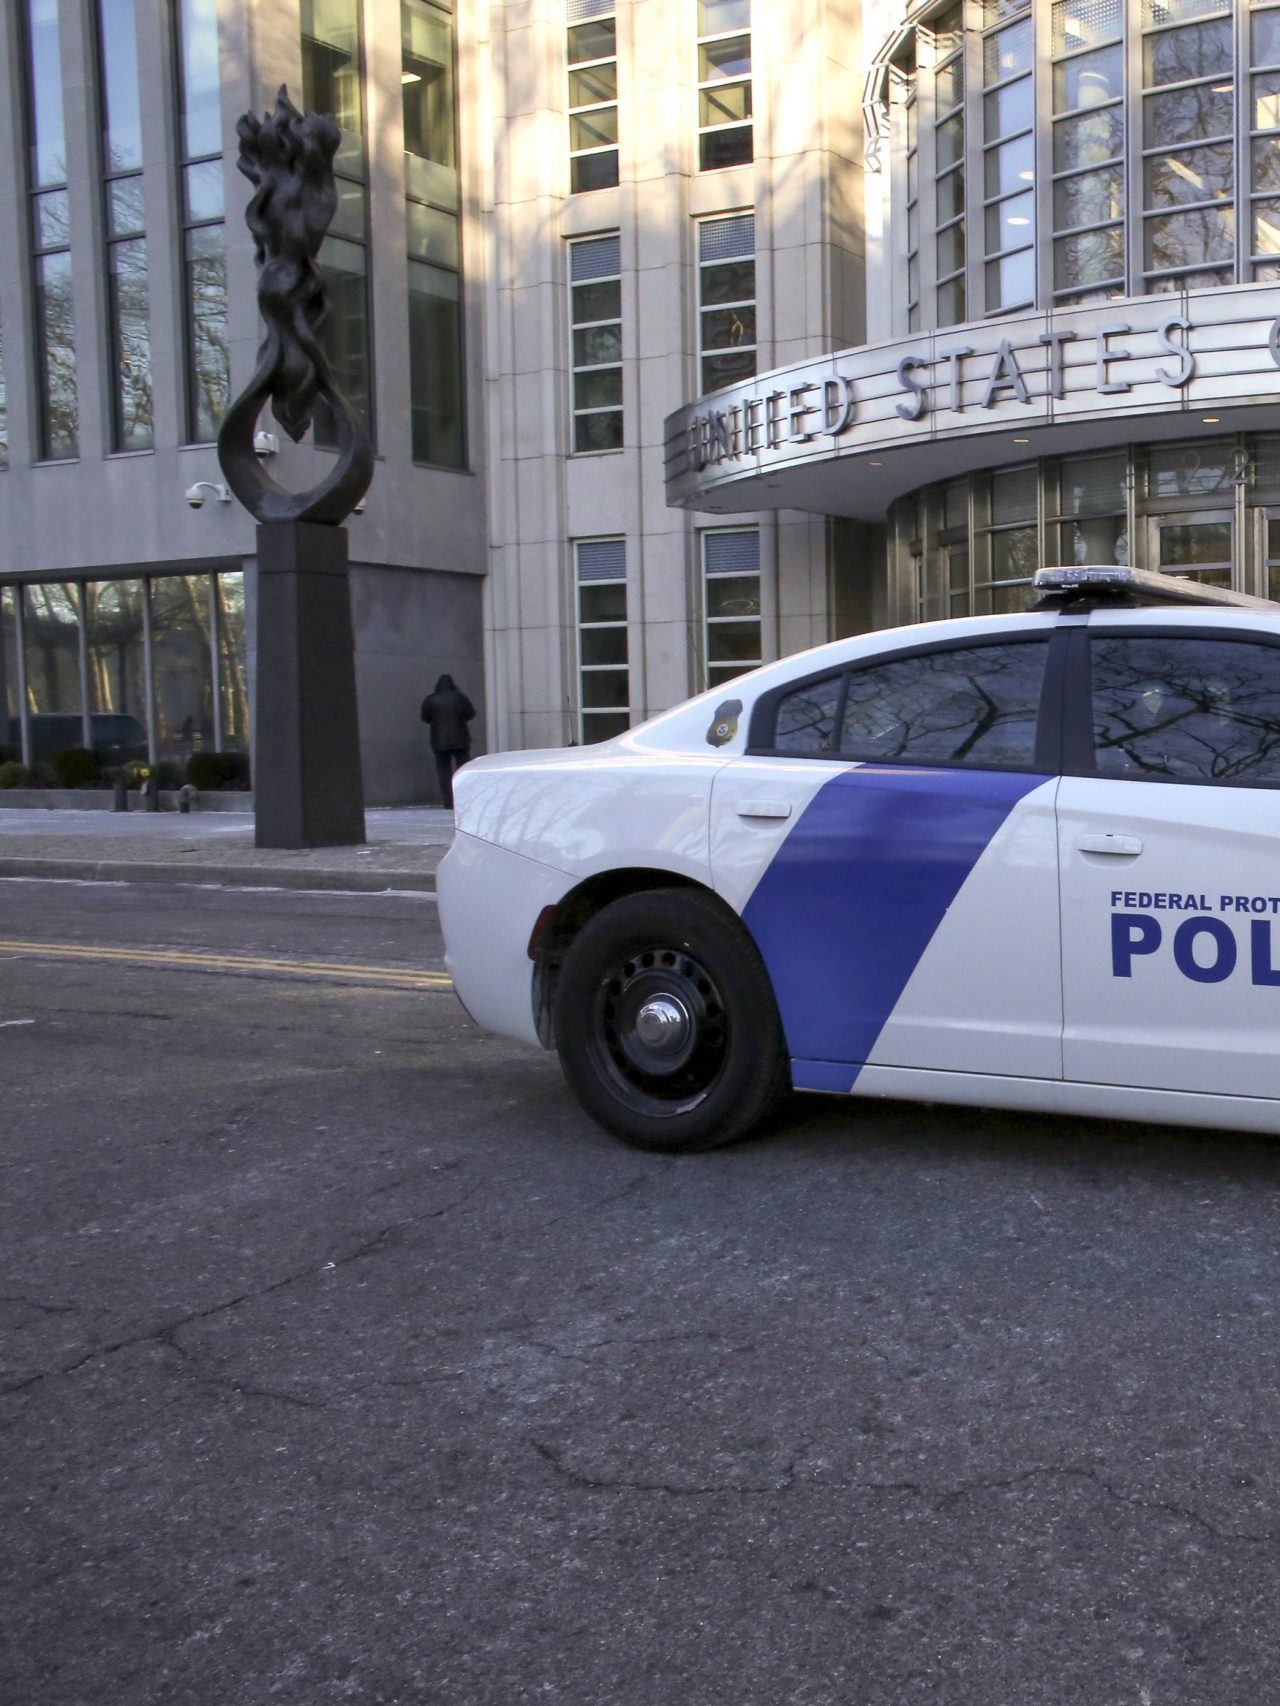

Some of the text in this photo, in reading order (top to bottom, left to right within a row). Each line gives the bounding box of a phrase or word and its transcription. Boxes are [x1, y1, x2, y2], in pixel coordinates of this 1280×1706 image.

[687, 375, 851, 472] UNITED
[895, 315, 1196, 422] STATES
[1110, 891, 1213, 912] FEDERAL
